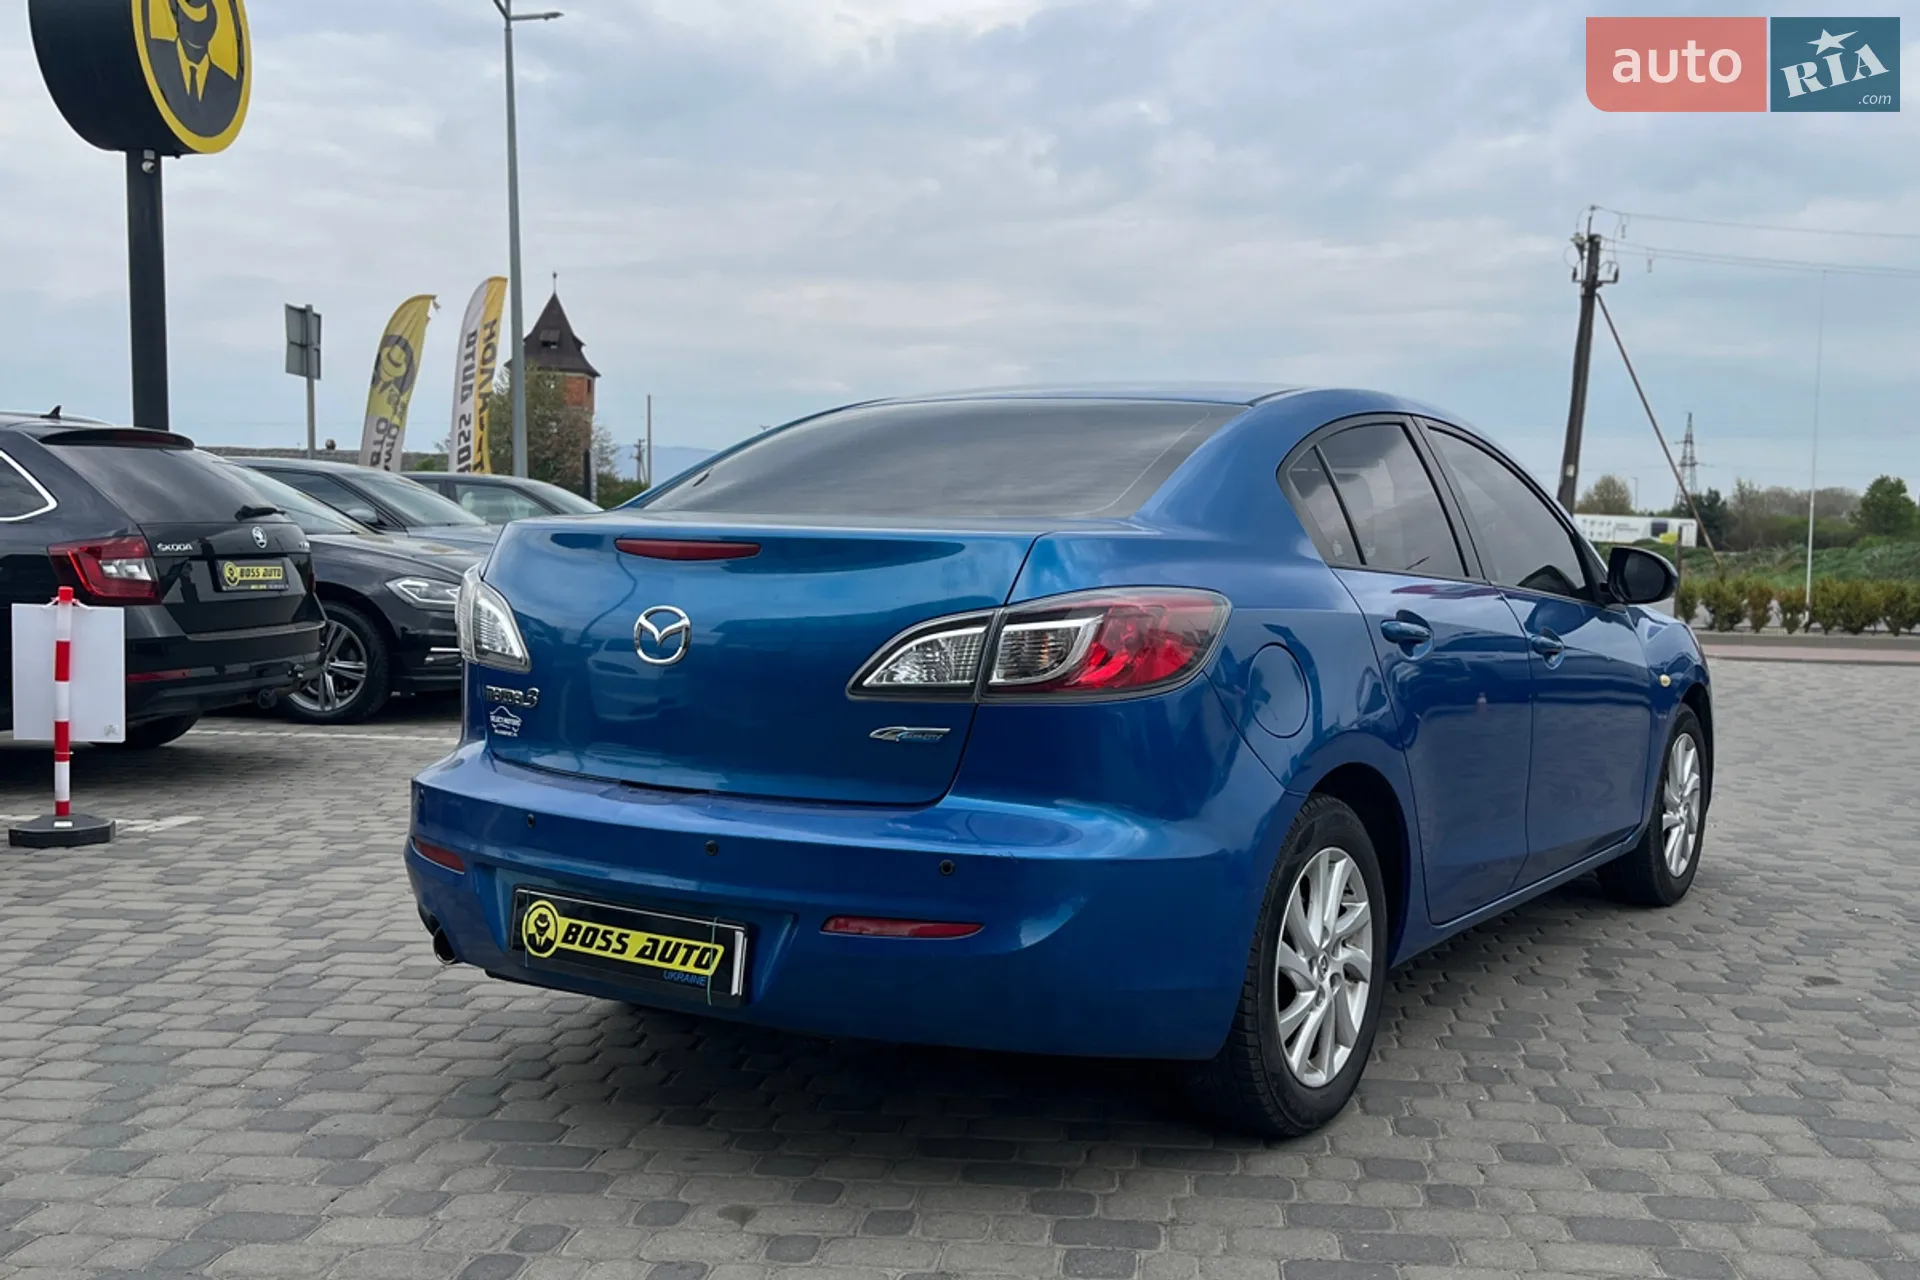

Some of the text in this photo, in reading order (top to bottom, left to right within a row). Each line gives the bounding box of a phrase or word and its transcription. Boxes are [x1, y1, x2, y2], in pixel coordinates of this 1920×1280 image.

[240, 568, 260, 578] BOSS
[560, 923, 717, 970] BOSS AUTO
[663, 970, 707, 987] UKRAINE
